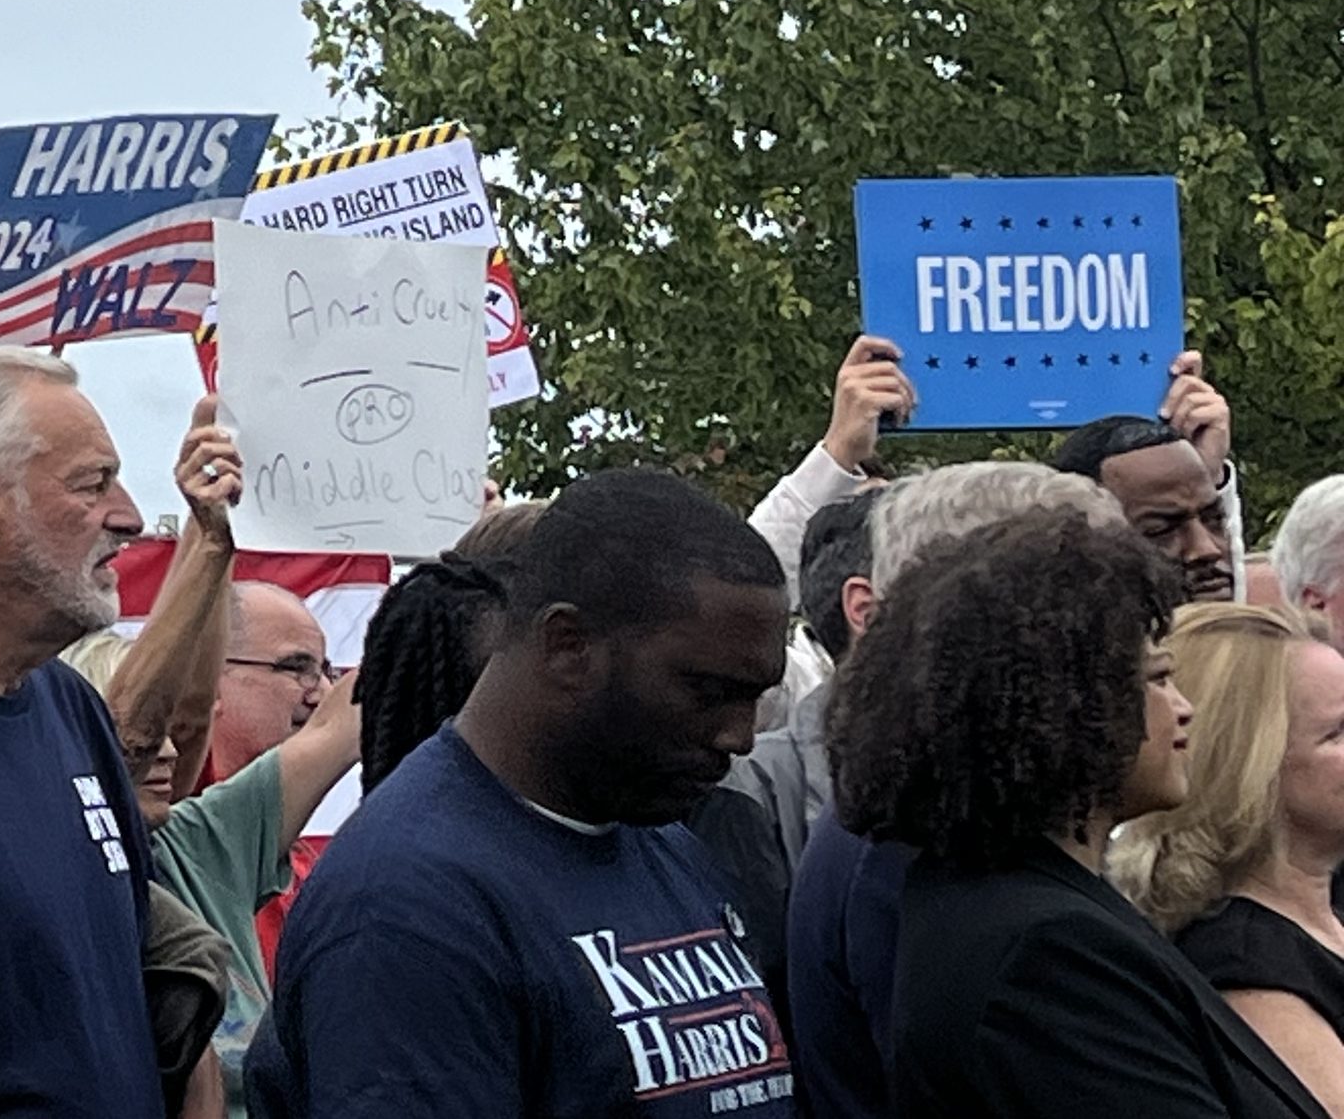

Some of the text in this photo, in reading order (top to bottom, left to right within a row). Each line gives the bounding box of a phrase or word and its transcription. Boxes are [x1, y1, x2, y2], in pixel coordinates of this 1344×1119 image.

[12, 118, 239, 198] HARRIS
[332, 181, 398, 222] RIGHT
[402, 164, 468, 203] TURN
[402, 202, 486, 243] ISLAND
[50, 258, 198, 338] WALZ
[916, 253, 1151, 334] FREEDOM
[254, 453, 405, 516] Middle
[615, 1013, 769, 1093] HARRIS
